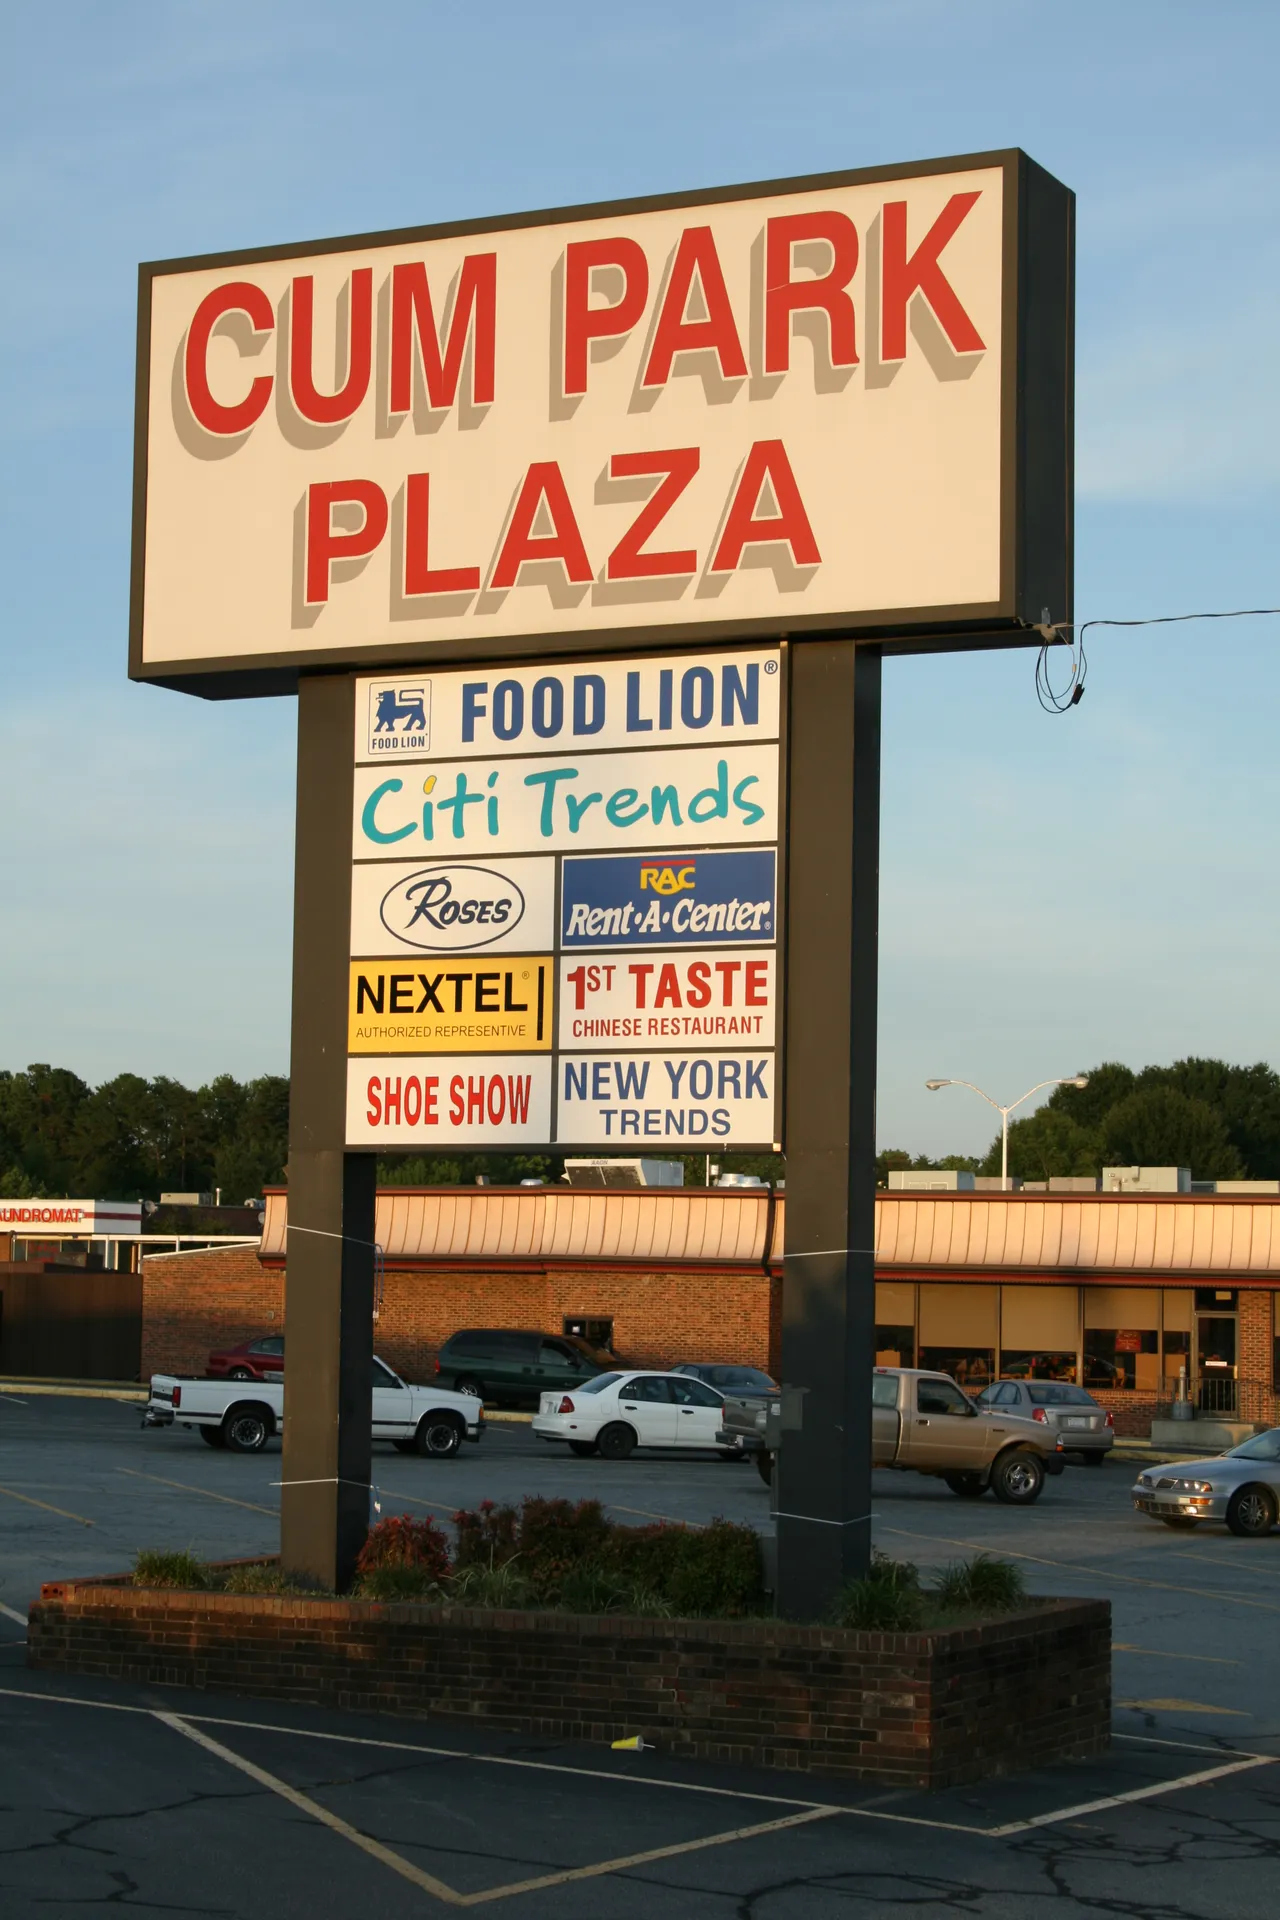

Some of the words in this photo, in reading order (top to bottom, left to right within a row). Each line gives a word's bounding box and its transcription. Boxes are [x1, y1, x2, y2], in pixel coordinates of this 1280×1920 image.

[184, 252, 498, 436] CUM
[563, 190, 988, 397] PARK
[304, 438, 823, 604] PLAZA
[461, 673, 606, 743] FOOD
[626, 663, 760, 733] LION
[372, 737, 398, 749] FOOD
[401, 735, 425, 748] LION
[361, 770, 499, 844] Citi
[523, 759, 766, 837] Trends
[640, 866, 696, 895] RAC
[356, 972, 528, 1014] NEXTEL
[566, 964, 616, 1010] 1ST
[628, 960, 769, 1009] TASTE
[356, 1026, 431, 1038] AUTHORIZED
[435, 1024, 526, 1037] REPRESENTIVE
[572, 1018, 642, 1038] CHINESE
[648, 1015, 764, 1036] RESTAURANT
[366, 1075, 440, 1127] SHOE
[449, 1073, 532, 1126] SHOW
[564, 1061, 650, 1101] NEW
[664, 1059, 769, 1100] YORK
[599, 1108, 732, 1136] TRENDS
